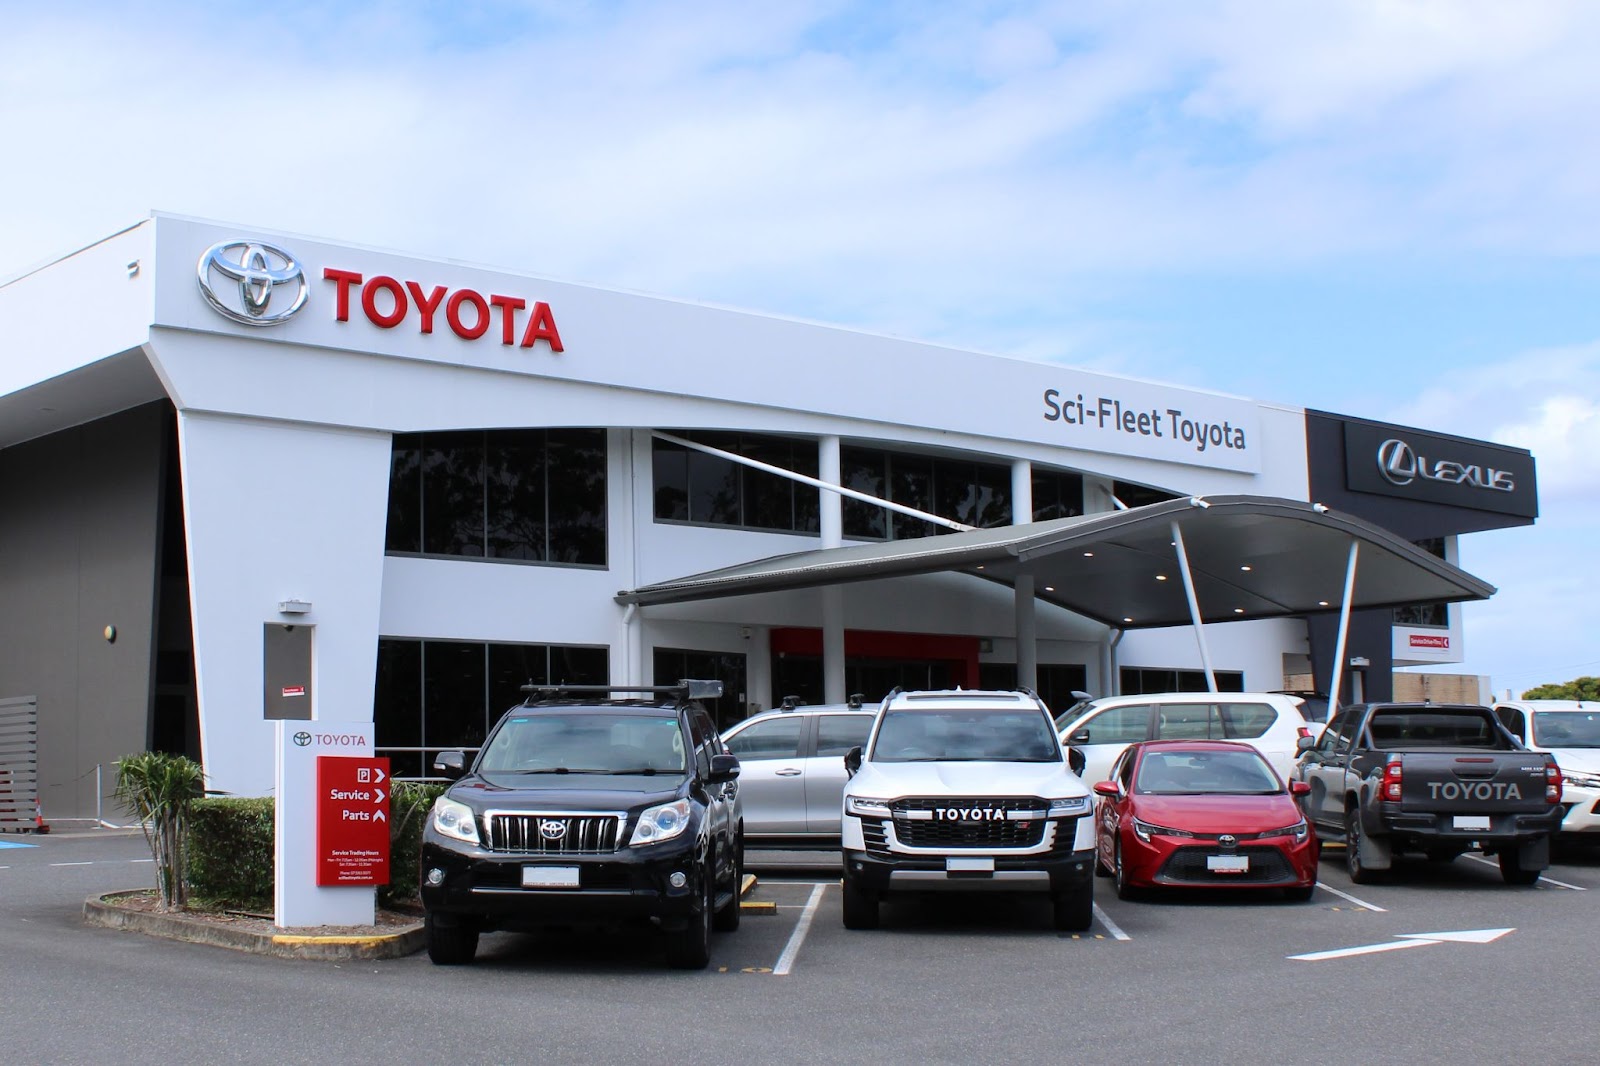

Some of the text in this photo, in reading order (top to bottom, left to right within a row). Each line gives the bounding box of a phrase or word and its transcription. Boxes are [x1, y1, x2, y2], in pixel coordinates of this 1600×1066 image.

[323, 267, 564, 353] TOYOTA
[1043, 388, 1246, 452] Sci-Fleet Toyota
[1417, 456, 1515, 492] LEXUS
[315, 734, 366, 746] TOYOTA
[330, 788, 370, 800] Service
[1427, 782, 1522, 800] TOYOTA
[342, 809, 370, 821] Parts
[936, 808, 1005, 821] TOYOTA
